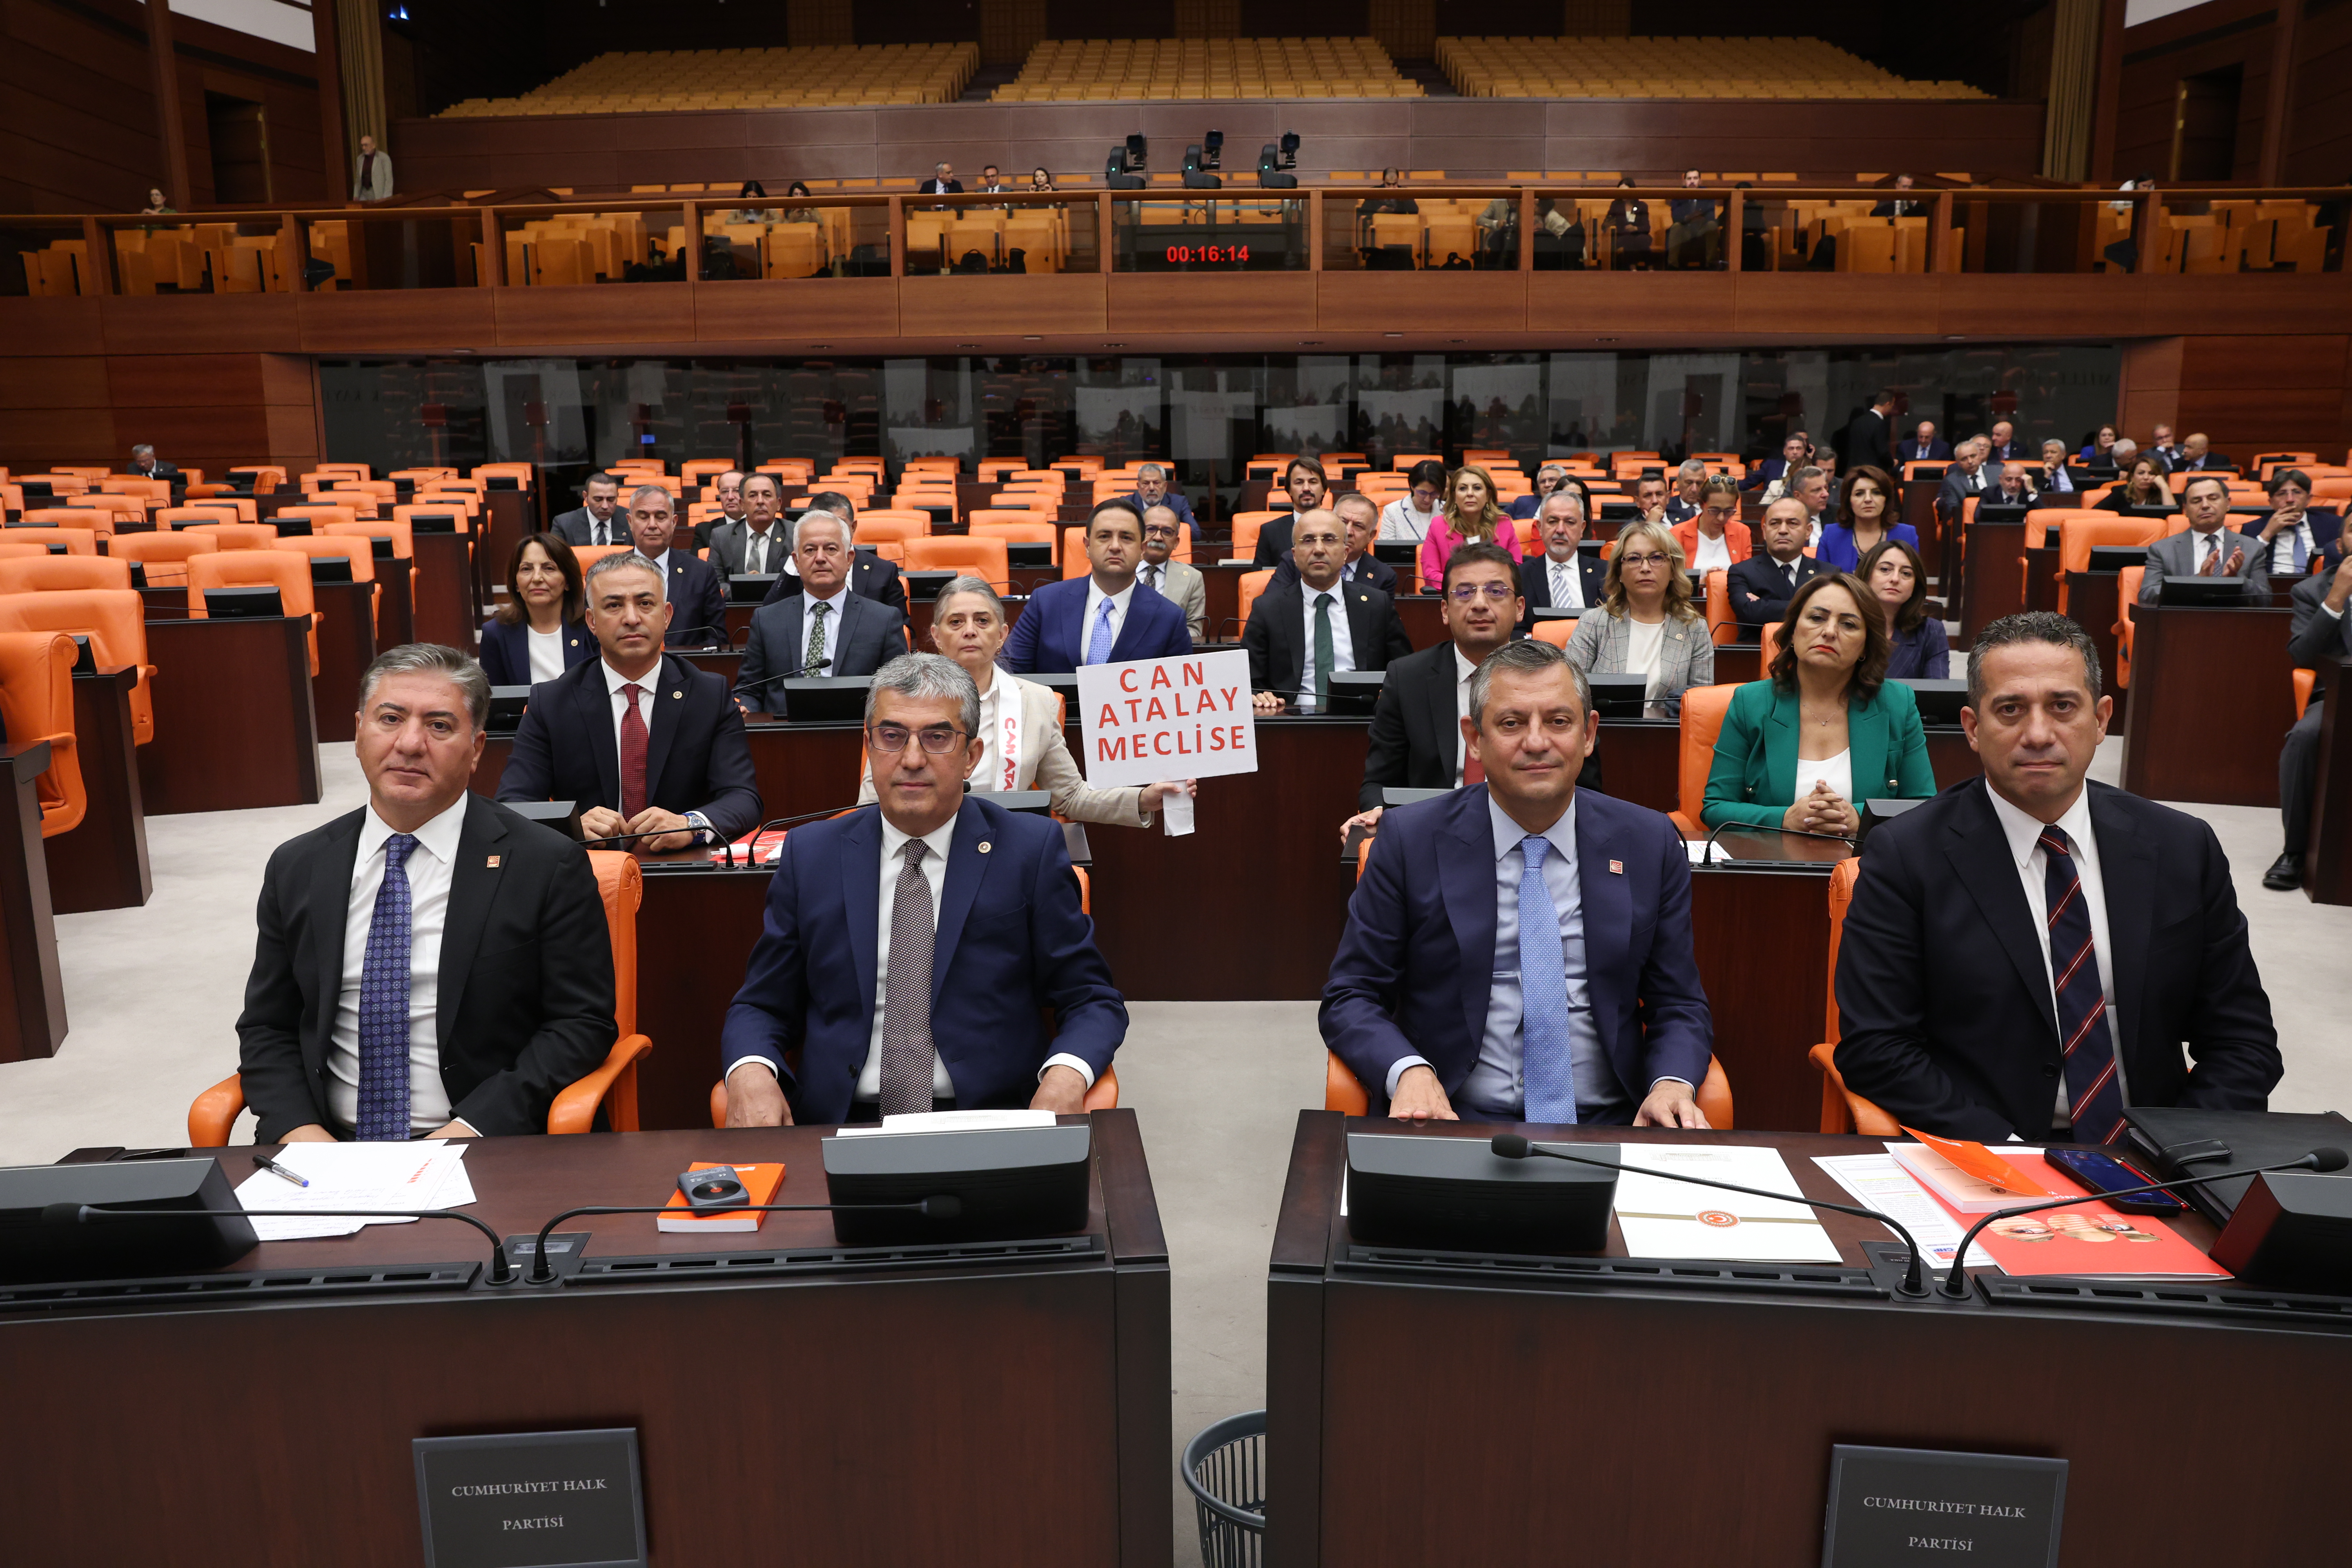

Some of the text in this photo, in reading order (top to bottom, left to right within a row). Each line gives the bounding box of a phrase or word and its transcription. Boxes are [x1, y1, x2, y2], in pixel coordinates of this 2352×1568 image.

[1166, 245, 1250, 262] 00:16:14
[1120, 661, 1203, 693] CAN
[1099, 687, 1238, 728] ATALAY
[1098, 724, 1245, 762] MECLİSE
[452, 1479, 607, 1497] CUMHURİYET HALK
[1863, 1497, 2026, 1518] CUMHURİYET HALK
[503, 1514, 564, 1530] PARTİSİ
[1908, 1536, 1973, 1552] PARTİSİ
